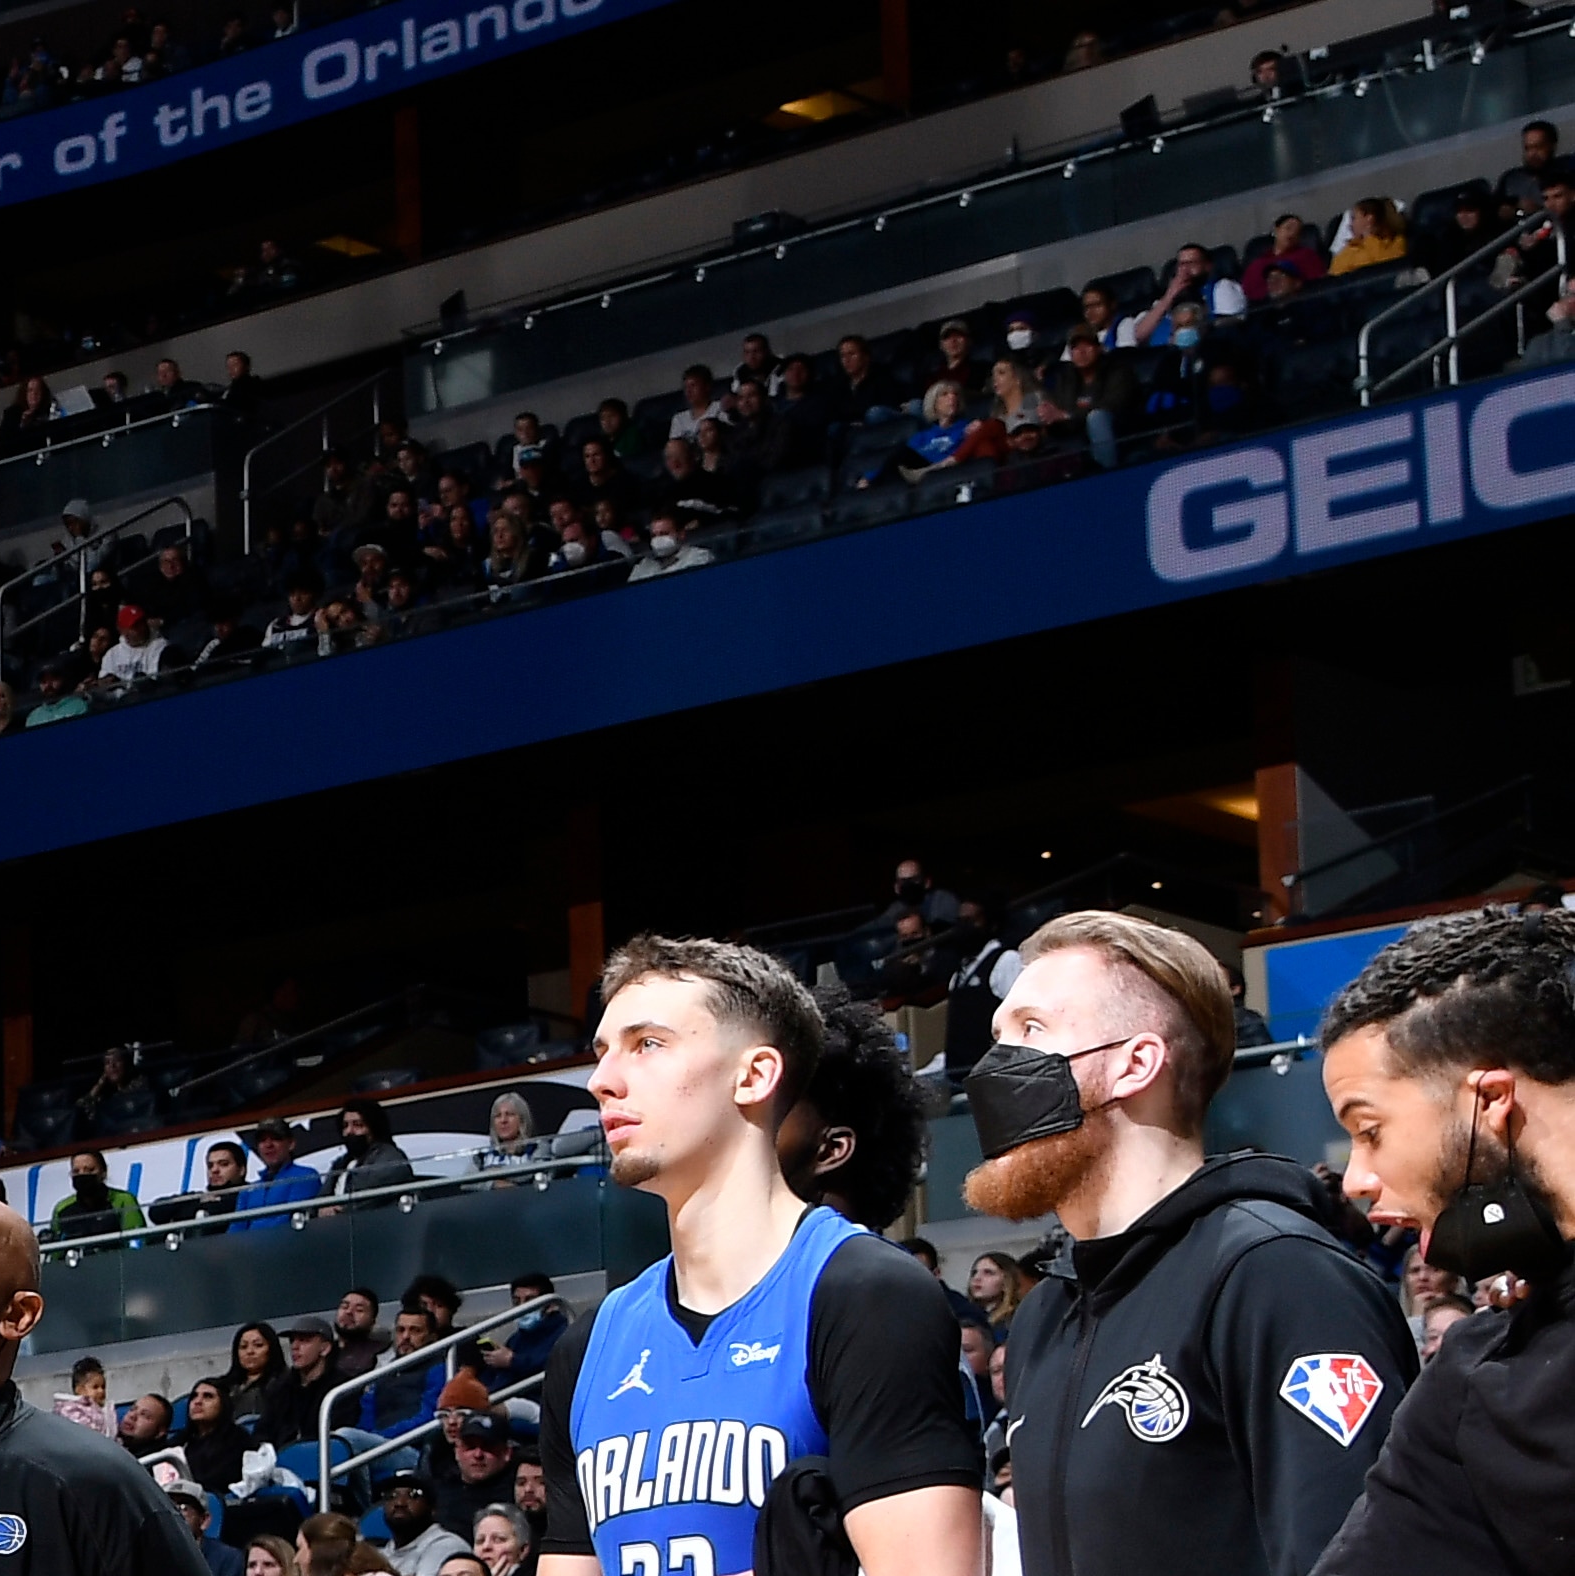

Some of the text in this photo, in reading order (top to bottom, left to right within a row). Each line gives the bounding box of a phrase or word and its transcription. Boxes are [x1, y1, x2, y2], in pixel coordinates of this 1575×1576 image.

[52, 112, 129, 176] of
[154, 82, 273, 149] the
[576, 1418, 789, 1538] ORLANDO
